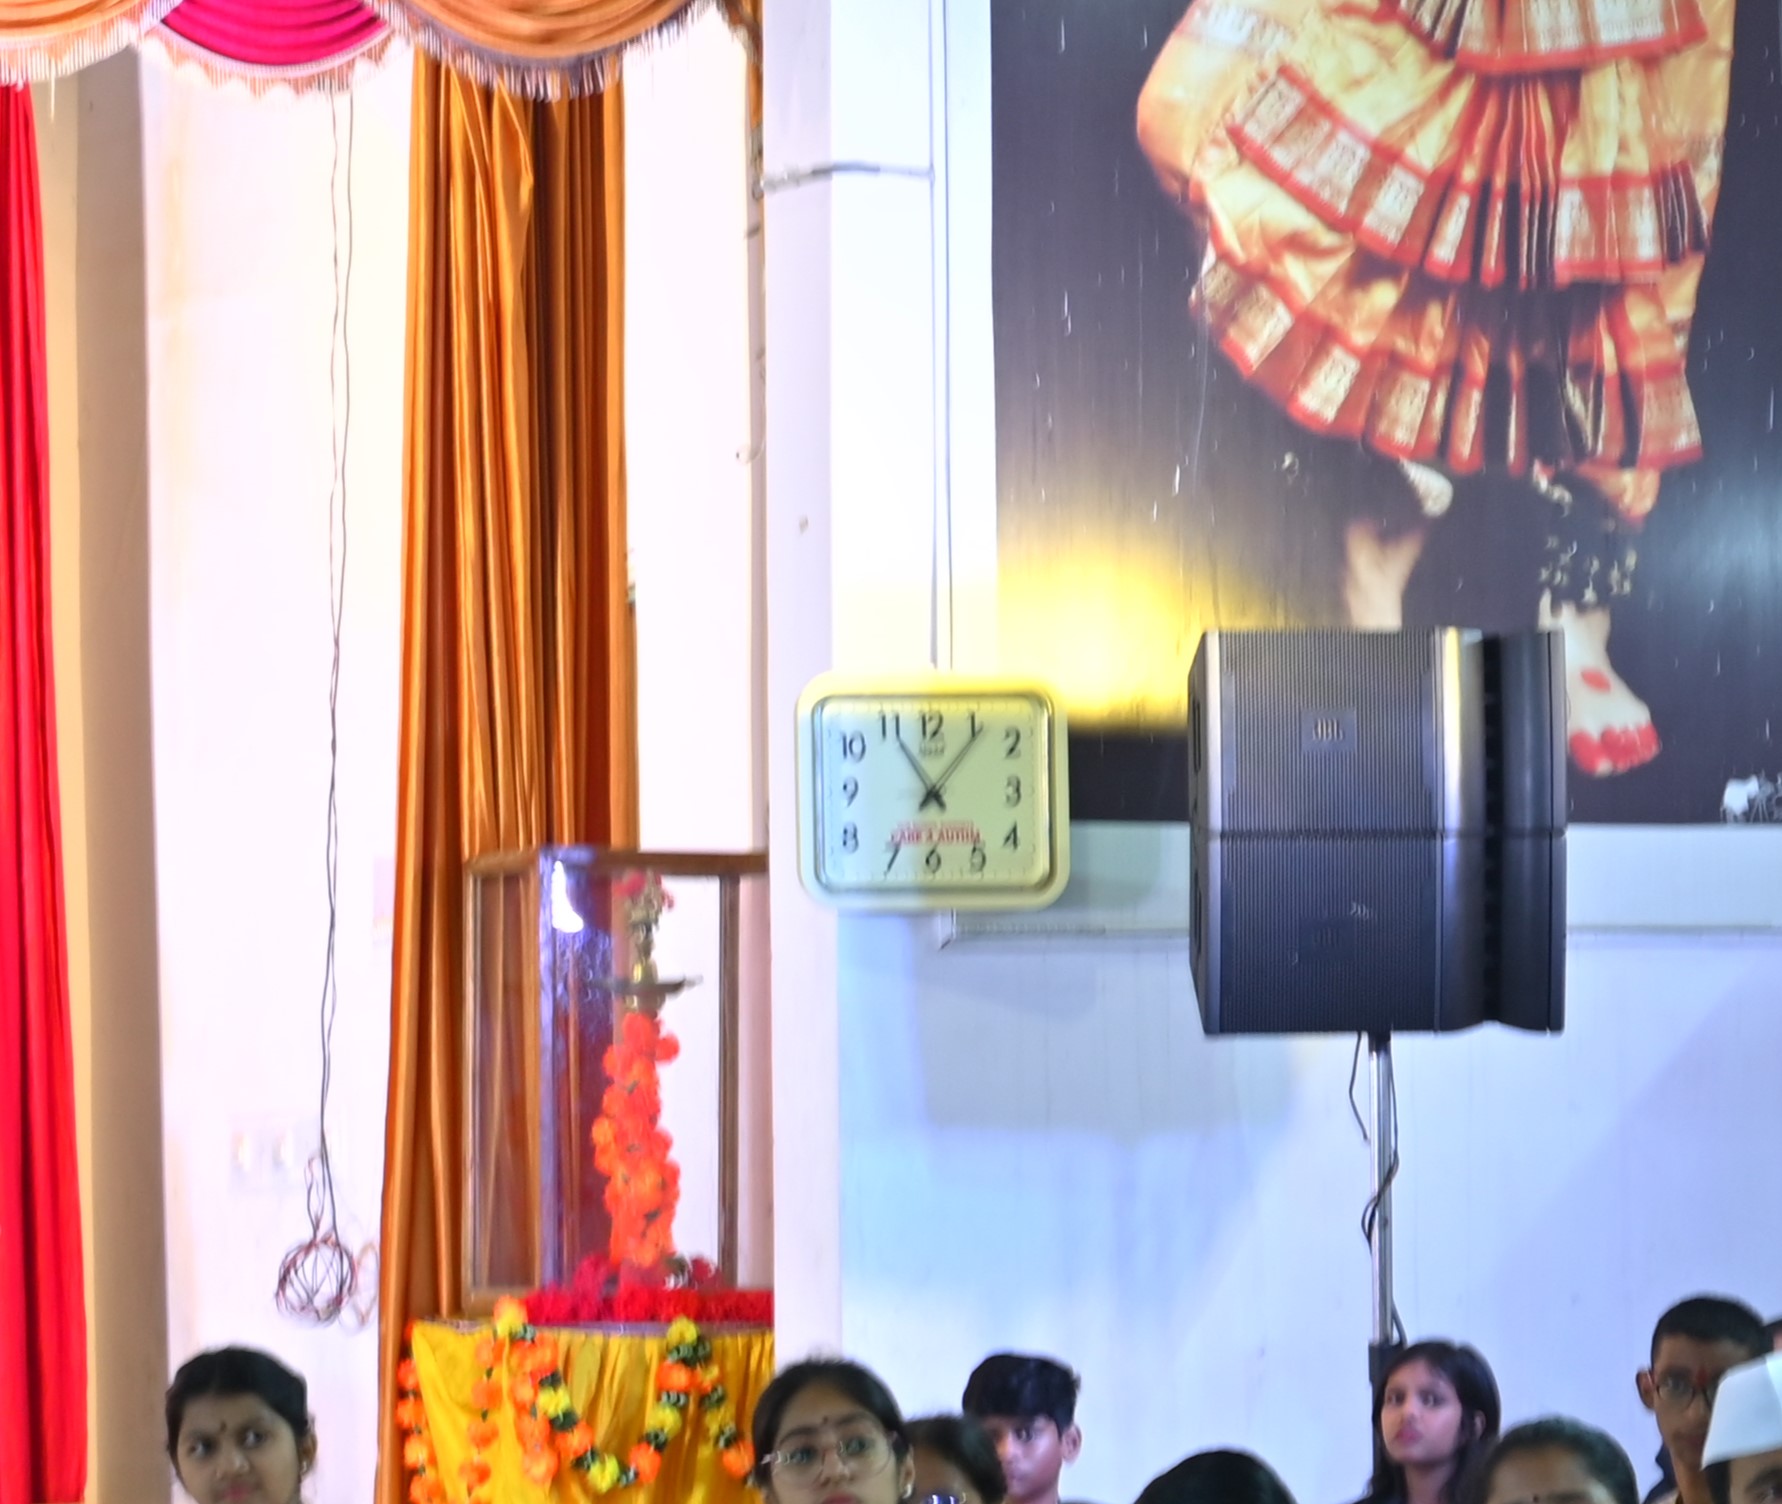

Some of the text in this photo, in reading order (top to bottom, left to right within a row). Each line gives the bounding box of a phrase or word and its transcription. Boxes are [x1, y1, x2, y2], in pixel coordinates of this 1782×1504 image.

[879, 711, 901, 740] 11
[919, 710, 944, 741] 12
[967, 710, 979, 740] 1
[840, 729, 867, 764] 10
[1003, 726, 1022, 760] 2
[842, 775, 860, 808] 9
[1004, 774, 1023, 808] 3
[842, 820, 860, 854] 8
[1003, 820, 1020, 851] 4
[884, 838, 902, 875] 7
[924, 841, 942, 875] 6
[969, 840, 987, 875] 5
